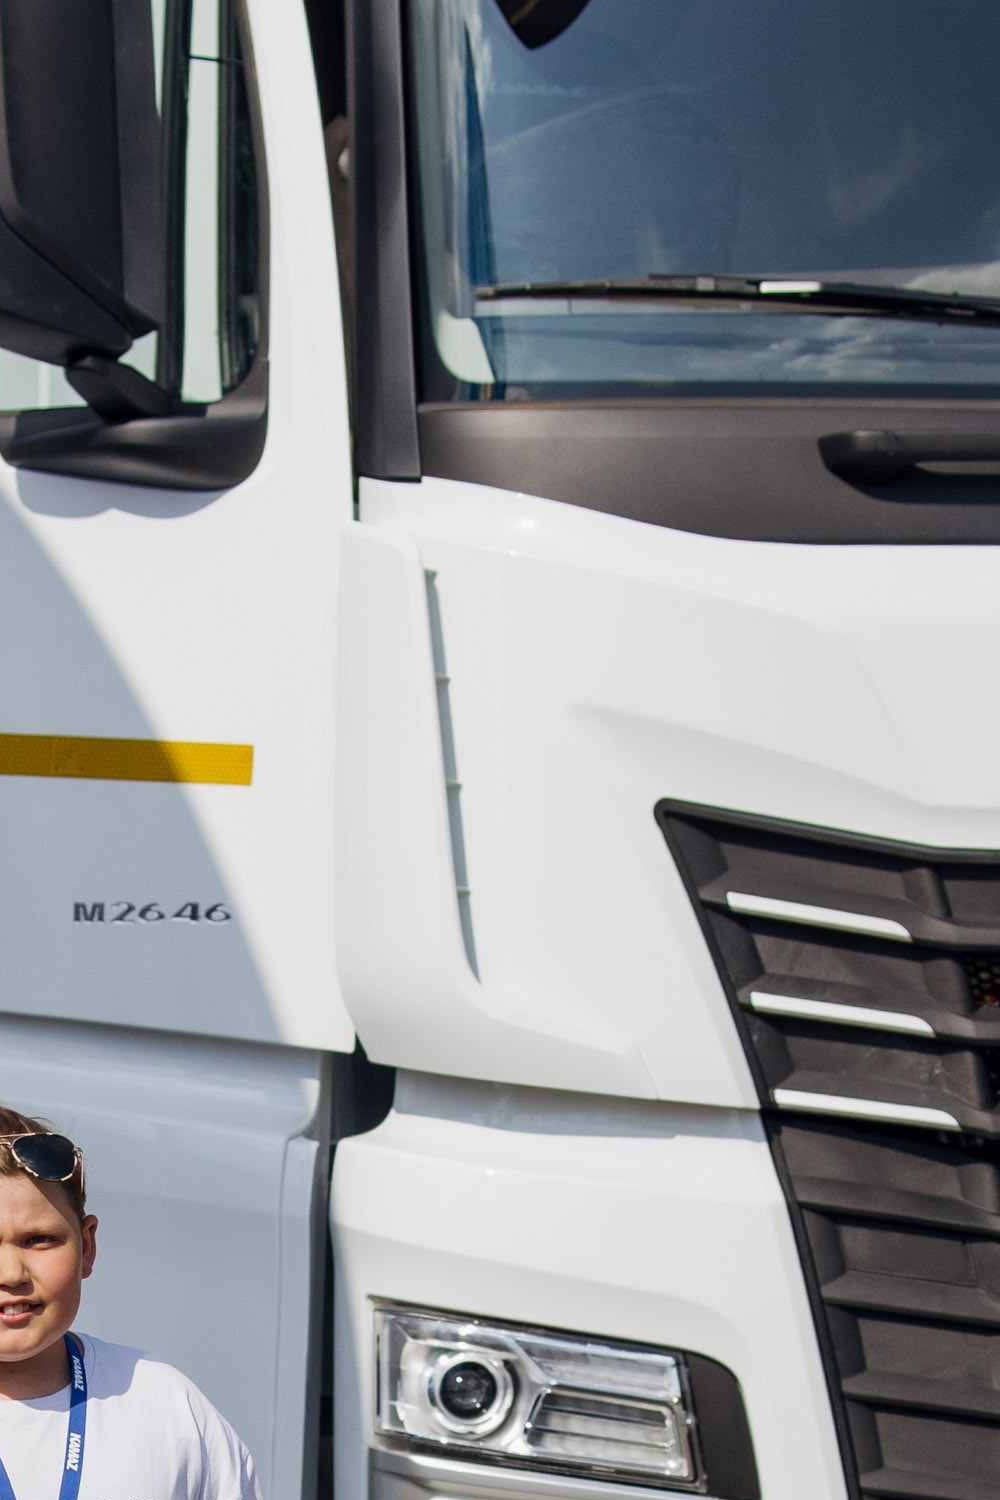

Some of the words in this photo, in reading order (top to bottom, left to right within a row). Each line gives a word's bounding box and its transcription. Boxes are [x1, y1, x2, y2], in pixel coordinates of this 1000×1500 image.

[72, 901, 232, 923] M2646
[72, 1355, 85, 1392] KAMAZ
[66, 1432, 82, 1472] KAMAZ
